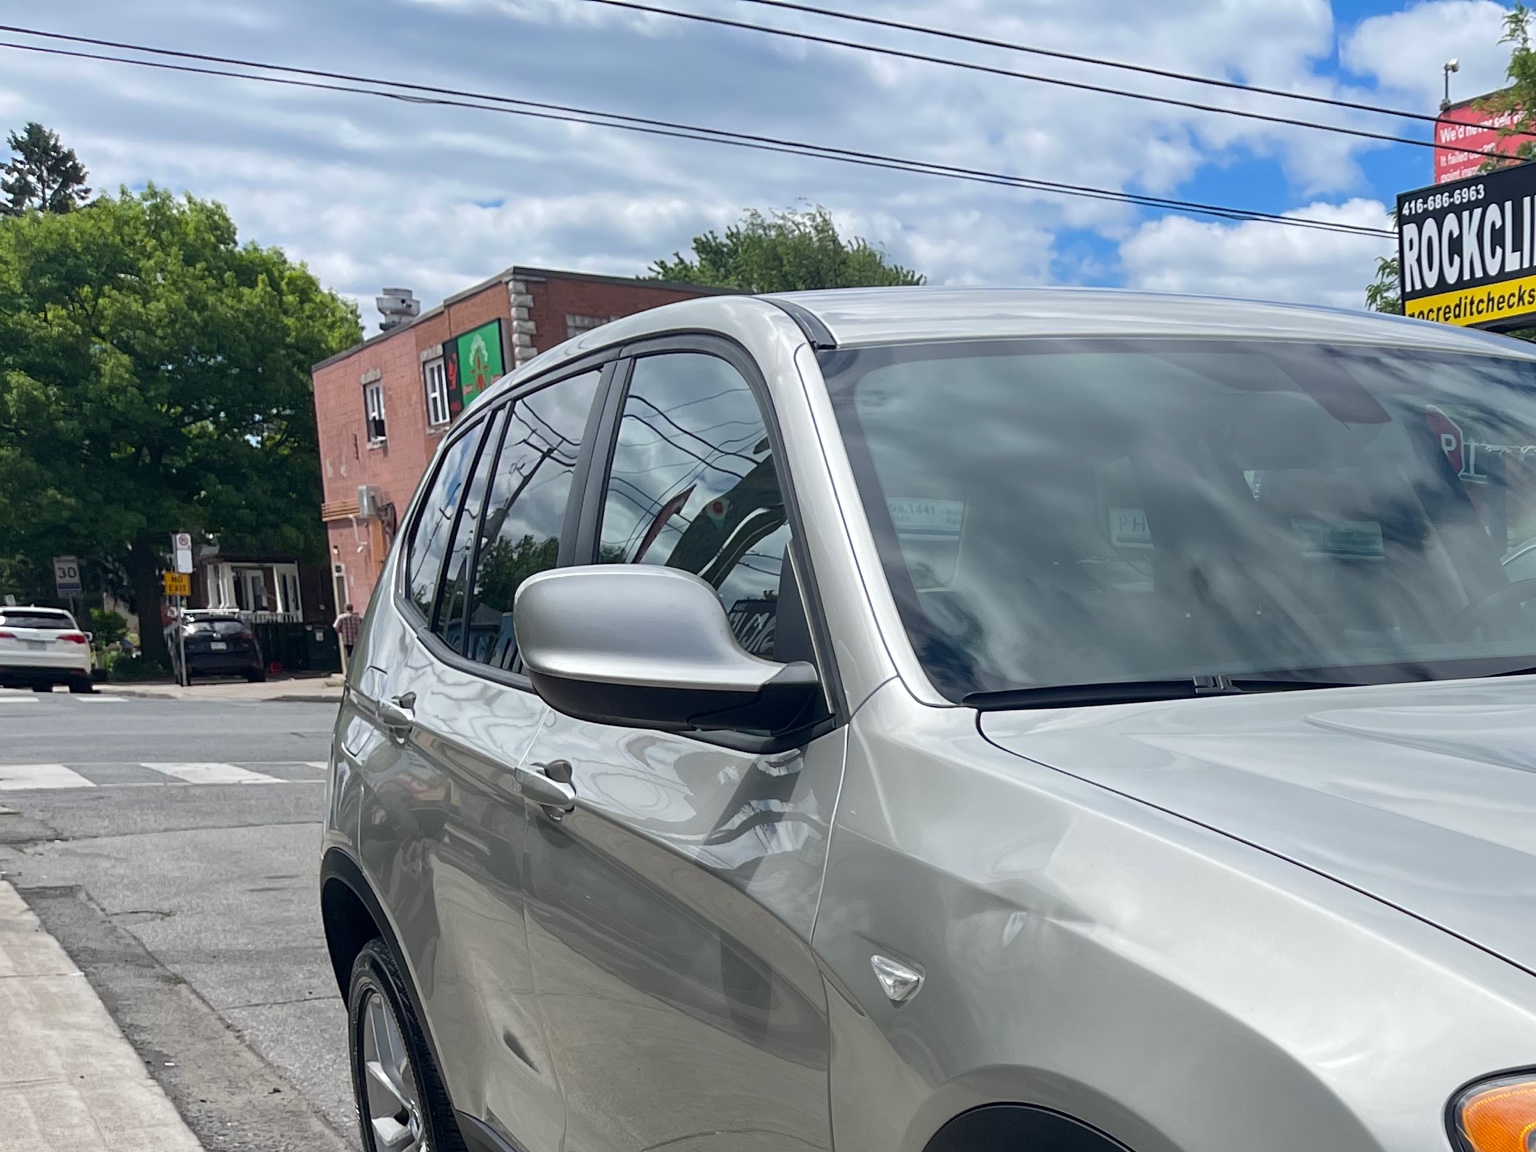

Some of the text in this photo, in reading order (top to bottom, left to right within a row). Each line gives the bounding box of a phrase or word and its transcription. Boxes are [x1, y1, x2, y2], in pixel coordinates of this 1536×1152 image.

[1440, 125, 1464, 143] We'd
[1402, 184, 1485, 216] 416-686-6963
[58, 567, 76, 579] 30
[169, 584, 187, 592] EXIT
